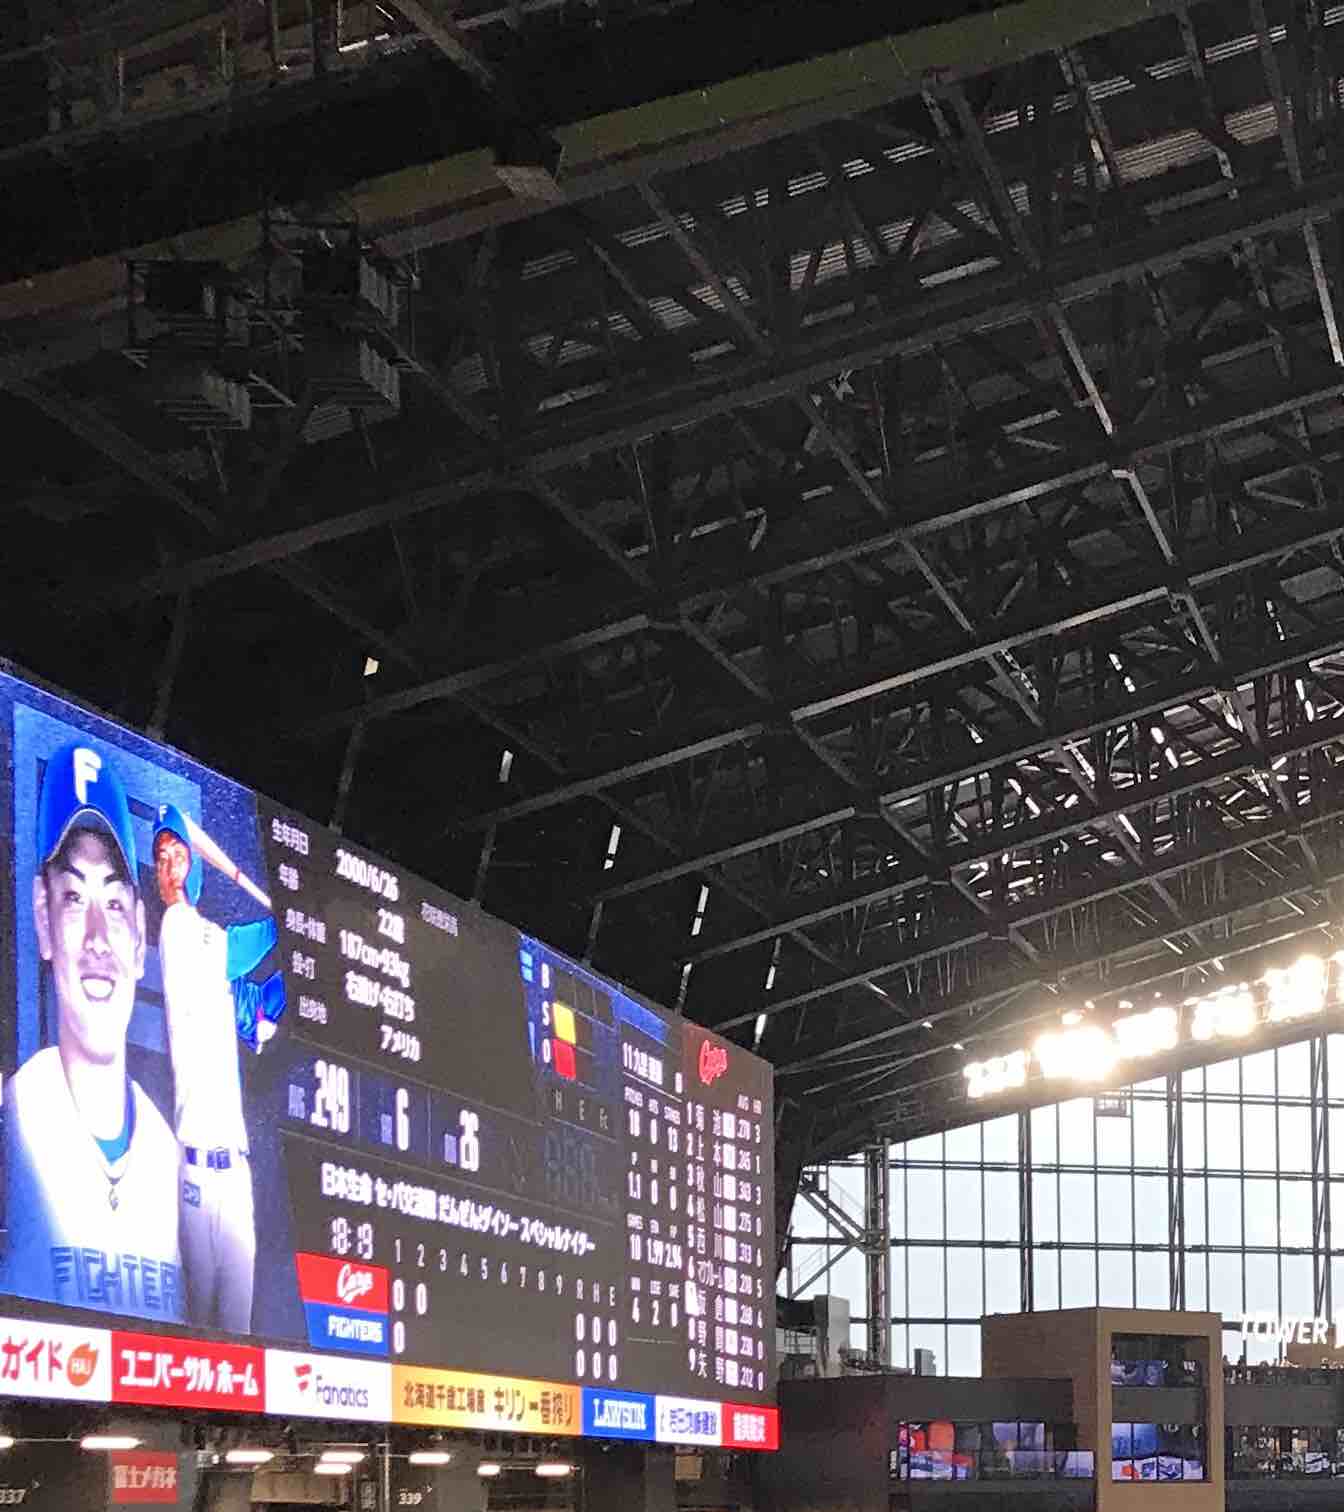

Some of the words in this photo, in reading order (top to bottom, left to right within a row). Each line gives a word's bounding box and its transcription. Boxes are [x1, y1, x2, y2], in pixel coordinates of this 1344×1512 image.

[74, 747, 101, 803] F
[272, 818, 309, 855] 生年月日
[336, 849, 399, 901] 2000/6/26
[542, 1001, 550, 1026] S
[381, 1025, 420, 1061] アメリカ
[396, 1088, 409, 1151] 6
[395, 1238, 402, 1263] 1
[417, 1243, 425, 1268] 2
[439, 1248, 448, 1272] 3
[460, 1253, 469, 1277] 4
[480, 1257, 488, 1280] 5
[537, 1270, 545, 1292] 8
[555, 1274, 563, 1296] 9
[392, 1279, 405, 1312] 0
[416, 1283, 427, 1315] 0
[576, 1313, 585, 1341] 0
[592, 1316, 601, 1344] 0
[608, 1319, 617, 1347] 0
[1241, 1312, 1329, 1345] TOWER
[1, 1335, 65, 1382] ガイド
[393, 1320, 405, 1354] 0
[576, 1349, 585, 1377] 0
[592, 1351, 601, 1379] 0
[609, 1354, 617, 1381] 0
[315, 1374, 369, 1409] Fanatics
[594, 1398, 647, 1431] LAWSON
[399, 1492, 422, 1506] 339
